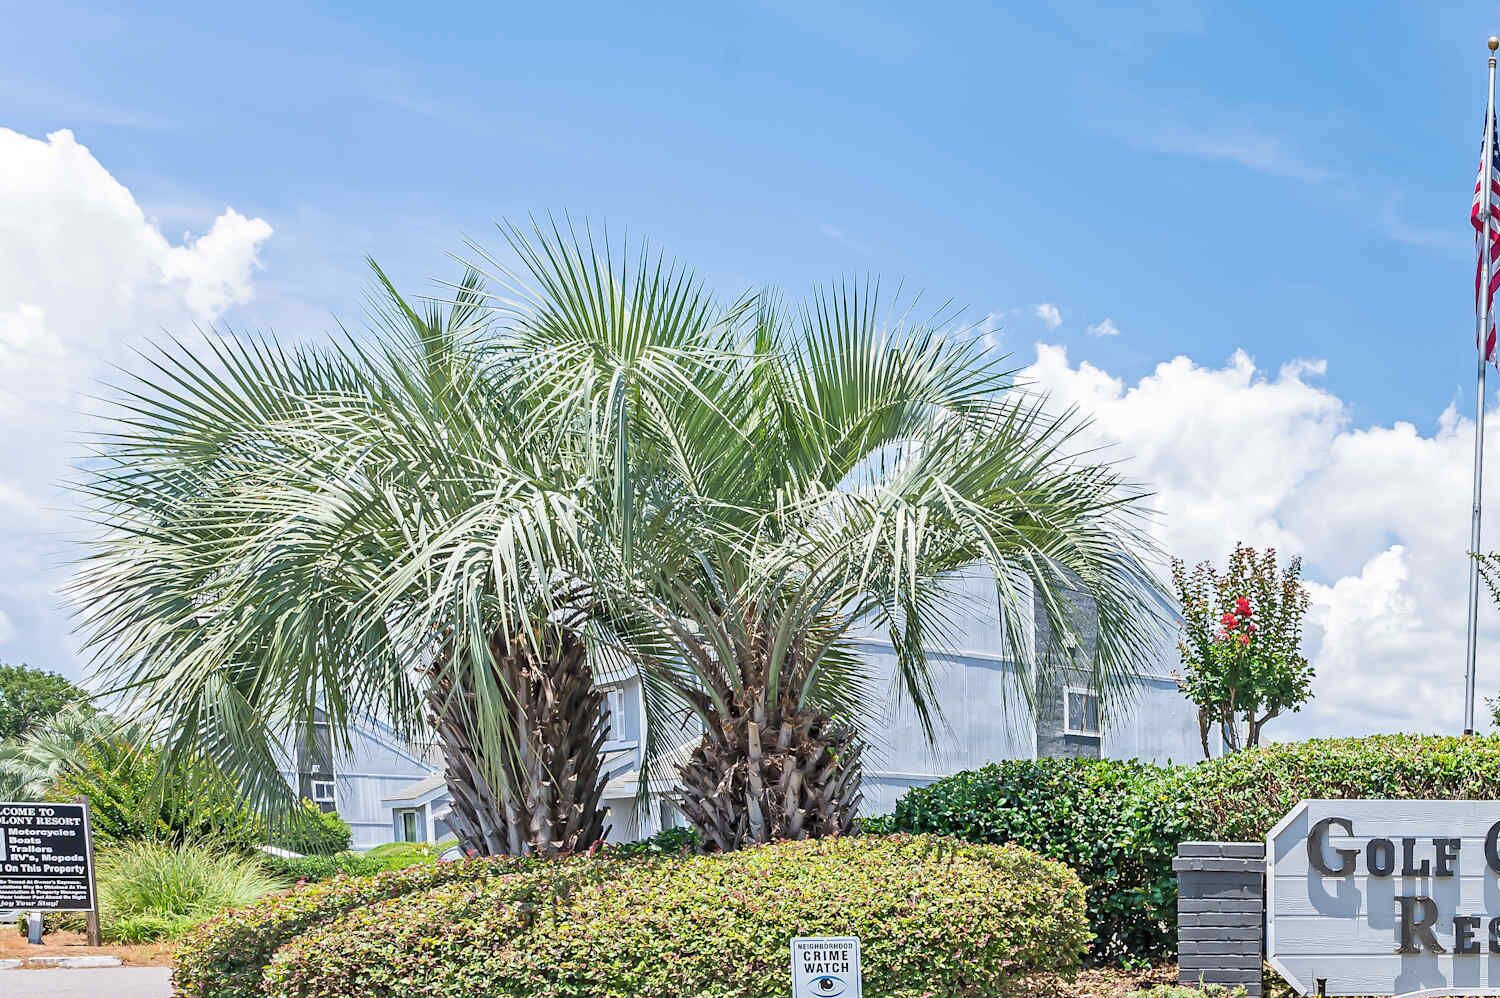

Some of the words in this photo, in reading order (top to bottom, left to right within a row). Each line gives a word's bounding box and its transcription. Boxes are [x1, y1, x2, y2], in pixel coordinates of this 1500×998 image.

[0, 808, 35, 816] COME
[39, 808, 55, 816] TO
[0, 816, 33, 825] LONY
[36, 817, 81, 826] RESORT
[8, 827, 76, 837] Motorcycles
[9, 845, 53, 853] Trailers
[1306, 817, 1461, 877] GOLF
[41, 854, 84, 863] Mopeds
[4, 864, 18, 872] On
[20, 864, 42, 872] This
[43, 864, 85, 875] Property
[803, 950, 848, 961] CRIME
[804, 962, 849, 973] WATCH
